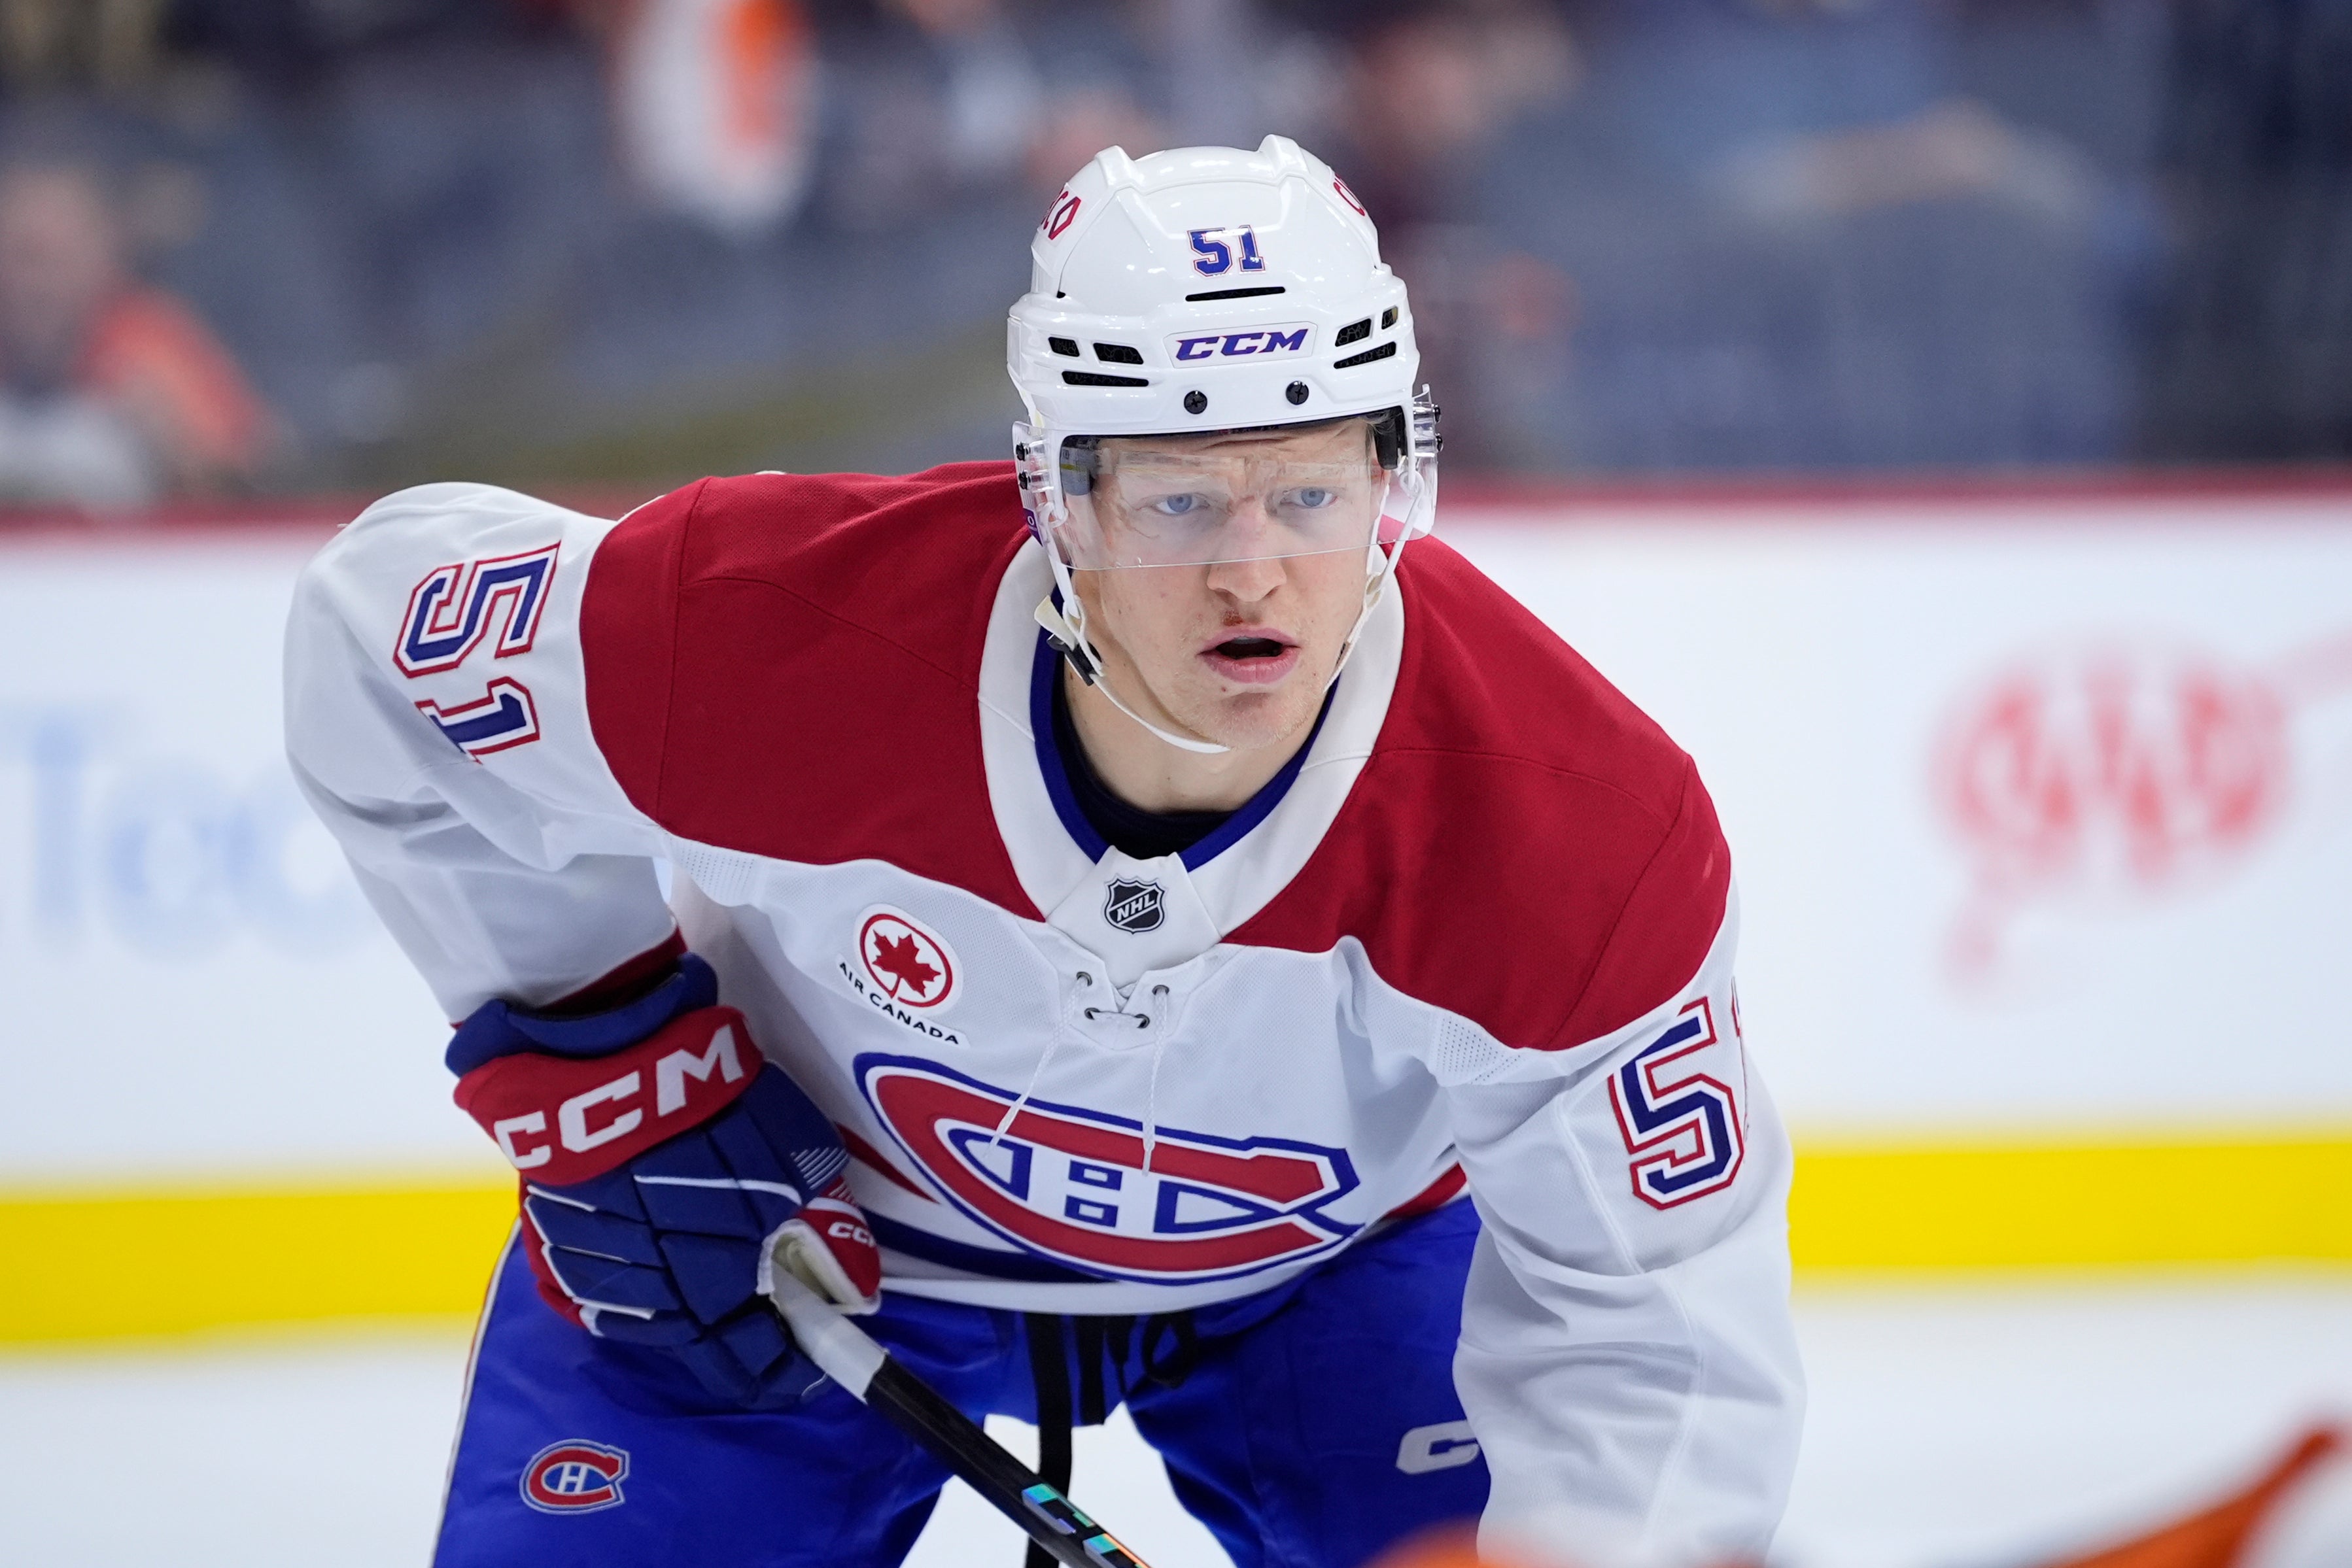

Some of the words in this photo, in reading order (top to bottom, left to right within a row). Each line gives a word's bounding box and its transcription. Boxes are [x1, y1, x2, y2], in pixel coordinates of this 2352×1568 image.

[1187, 225, 1265, 276] 51
[1176, 329, 1308, 360] CCM
[392, 541, 561, 765] 51
[1116, 893, 1155, 922] NHL
[840, 963, 864, 994] AIR
[869, 993, 959, 1044] CANADA
[493, 1025, 744, 1169] CCM
[1608, 976, 1748, 1210] 5
[827, 1221, 875, 1248] CC
